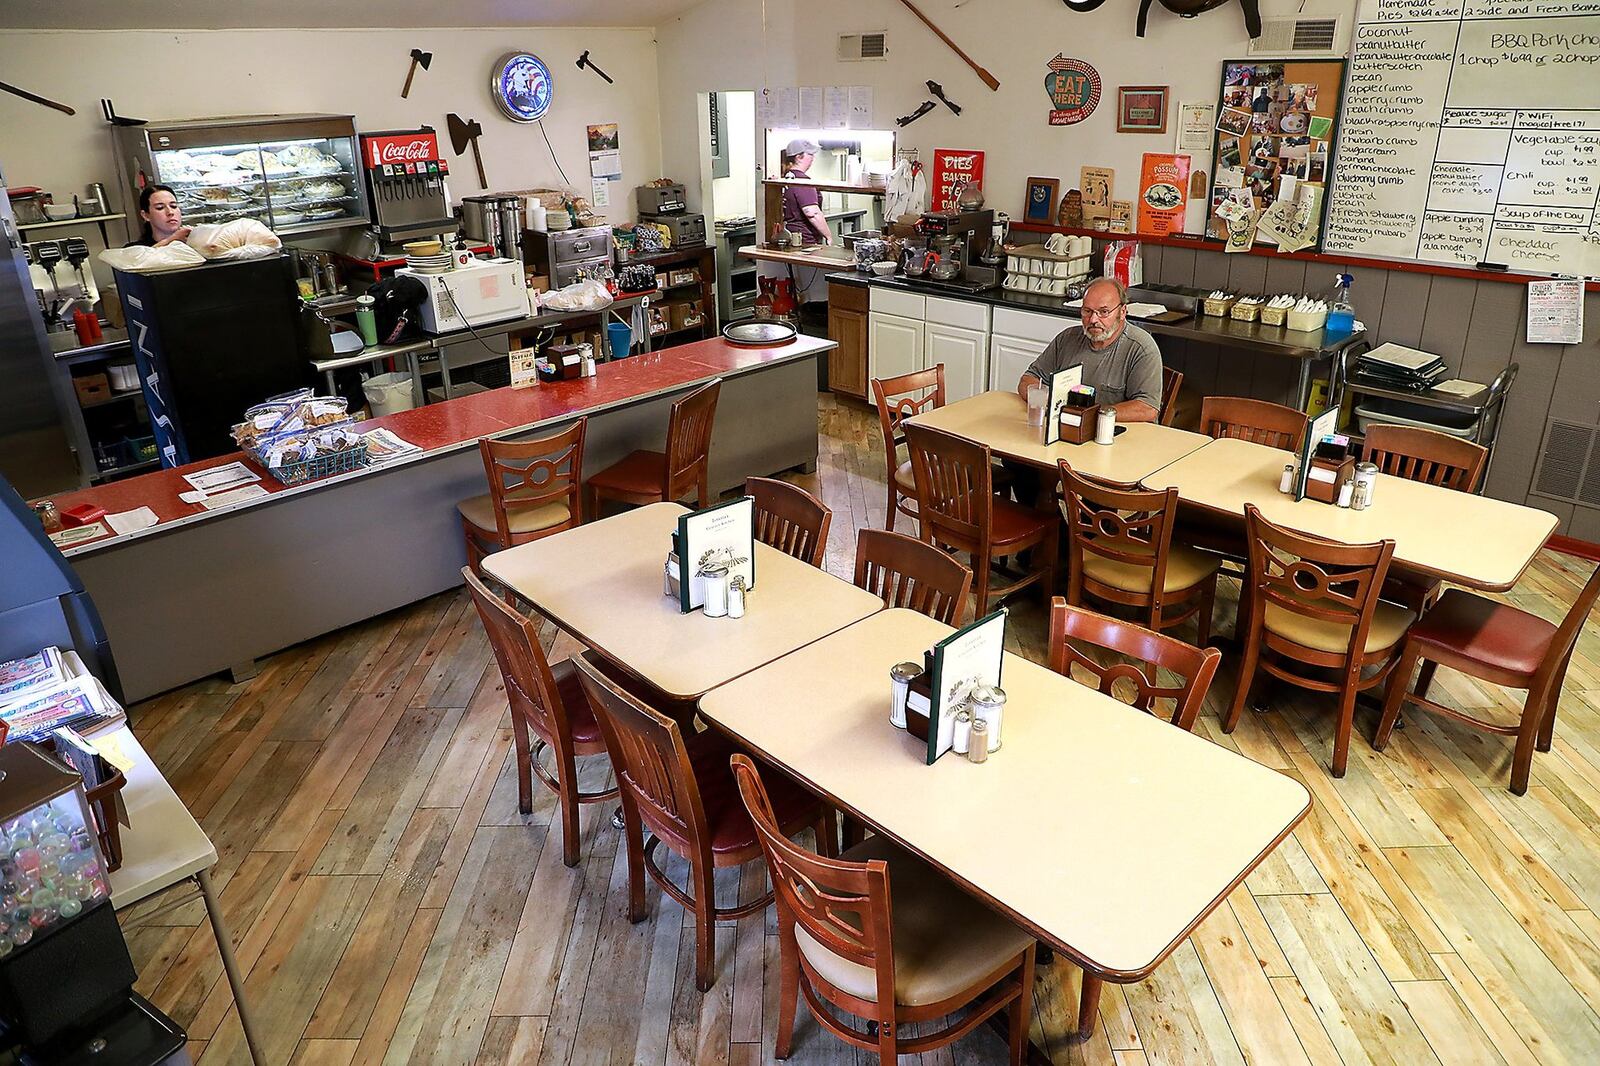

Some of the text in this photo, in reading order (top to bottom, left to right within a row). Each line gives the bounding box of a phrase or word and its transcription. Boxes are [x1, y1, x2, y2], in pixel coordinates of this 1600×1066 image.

[1377, 11, 1403, 20] Pies
[1476, 7, 1502, 15] side
[1508, 6, 1529, 15] and
[1358, 27, 1413, 38] Coconut
[1491, 33, 1600, 50] BBQ Pork Cho
[1535, 55, 1547, 66] or
[1352, 74, 1383, 82] pecan
[1055, 75, 1086, 93] EAT
[1054, 93, 1082, 105] HERE
[1342, 136, 1418, 146] rhubarb crumb
[1514, 134, 1600, 146] Vegetable Sou
[383, 140, 431, 161] Coca-Cola
[1544, 149, 1563, 157] cup
[944, 156, 972, 170] PIES
[1339, 154, 1376, 164] banana
[942, 172, 972, 183] BAKED
[1506, 171, 1533, 180] Chili
[1335, 183, 1363, 191] lemon
[1332, 192, 1377, 201] custard
[1332, 199, 1365, 207] peach
[1337, 208, 1369, 217] Fresh
[1500, 207, 1531, 219] Soup
[1564, 211, 1585, 223] Day
[1425, 213, 1451, 223] apple
[1329, 232, 1367, 242] rhubarb
[1421, 233, 1446, 241] apple
[1327, 241, 1354, 249] apple
[1499, 237, 1558, 250] Cheddar
